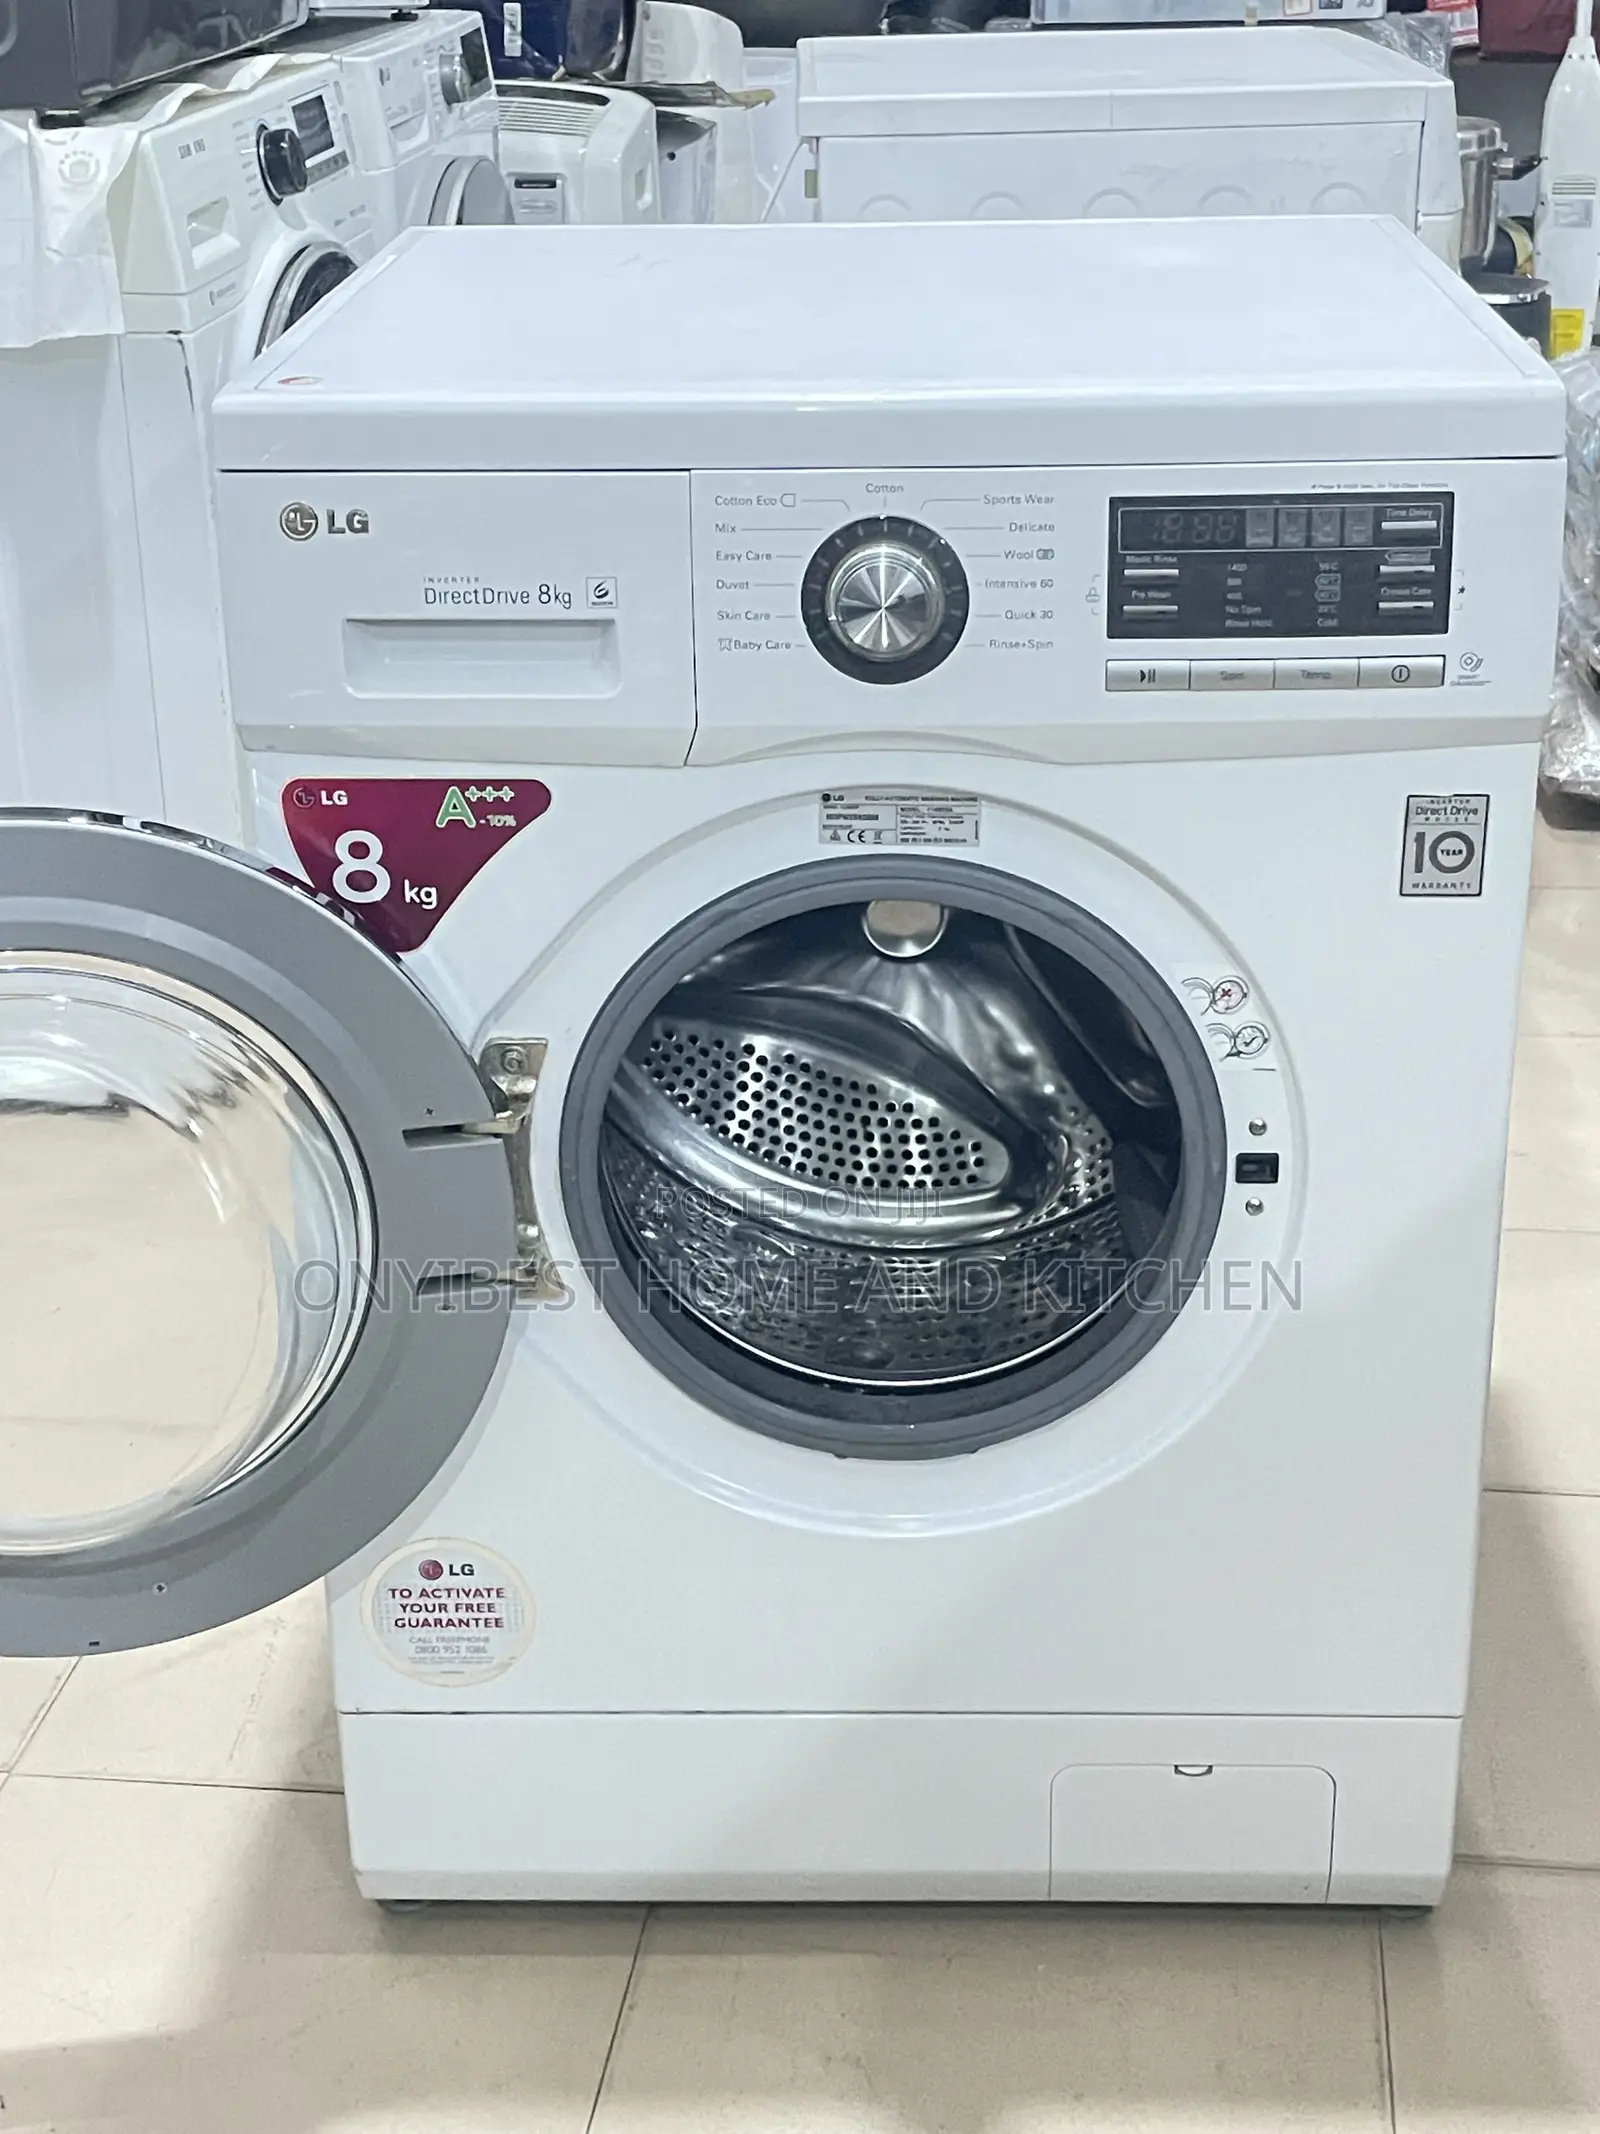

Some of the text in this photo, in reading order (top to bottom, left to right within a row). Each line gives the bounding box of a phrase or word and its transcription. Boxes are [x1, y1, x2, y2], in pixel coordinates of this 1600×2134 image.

[865, 483, 904, 494] Cotton
[715, 495, 777, 507] Cotton Eco
[983, 494, 1055, 506] Sports Wear
[326, 509, 369, 534] LG
[1008, 522, 1055, 532] Delicate
[715, 523, 737, 534] Mix
[715, 550, 772, 562] Easy Care
[1004, 550, 1034, 560] Wool
[422, 576, 481, 584] INVERTER
[984, 578, 1037, 589] Intensive
[717, 610, 771, 621] Skin Care
[1004, 609, 1054, 620] Quick 30
[734, 639, 791, 651] Baby Care
[989, 639, 1054, 651] Rinse+Spin
[321, 790, 348, 806] LG
[832, 794, 845, 802] LG
[435, 783, 515, 828] A+++
[1415, 805, 1479, 816] Direct Drive
[1413, 830, 1476, 874] 10
[1440, 848, 1464, 857] YEAR
[332, 830, 437, 910] 8 kg
[1411, 882, 1472, 890] WARRANTY
[448, 1563, 475, 1577] LG
[388, 1587, 506, 1599] TO ACTIVATE
[399, 1603, 497, 1613] YOUR FREE
[394, 1617, 505, 1629] GUARANTEE
[409, 1636, 433, 1644] CALL
